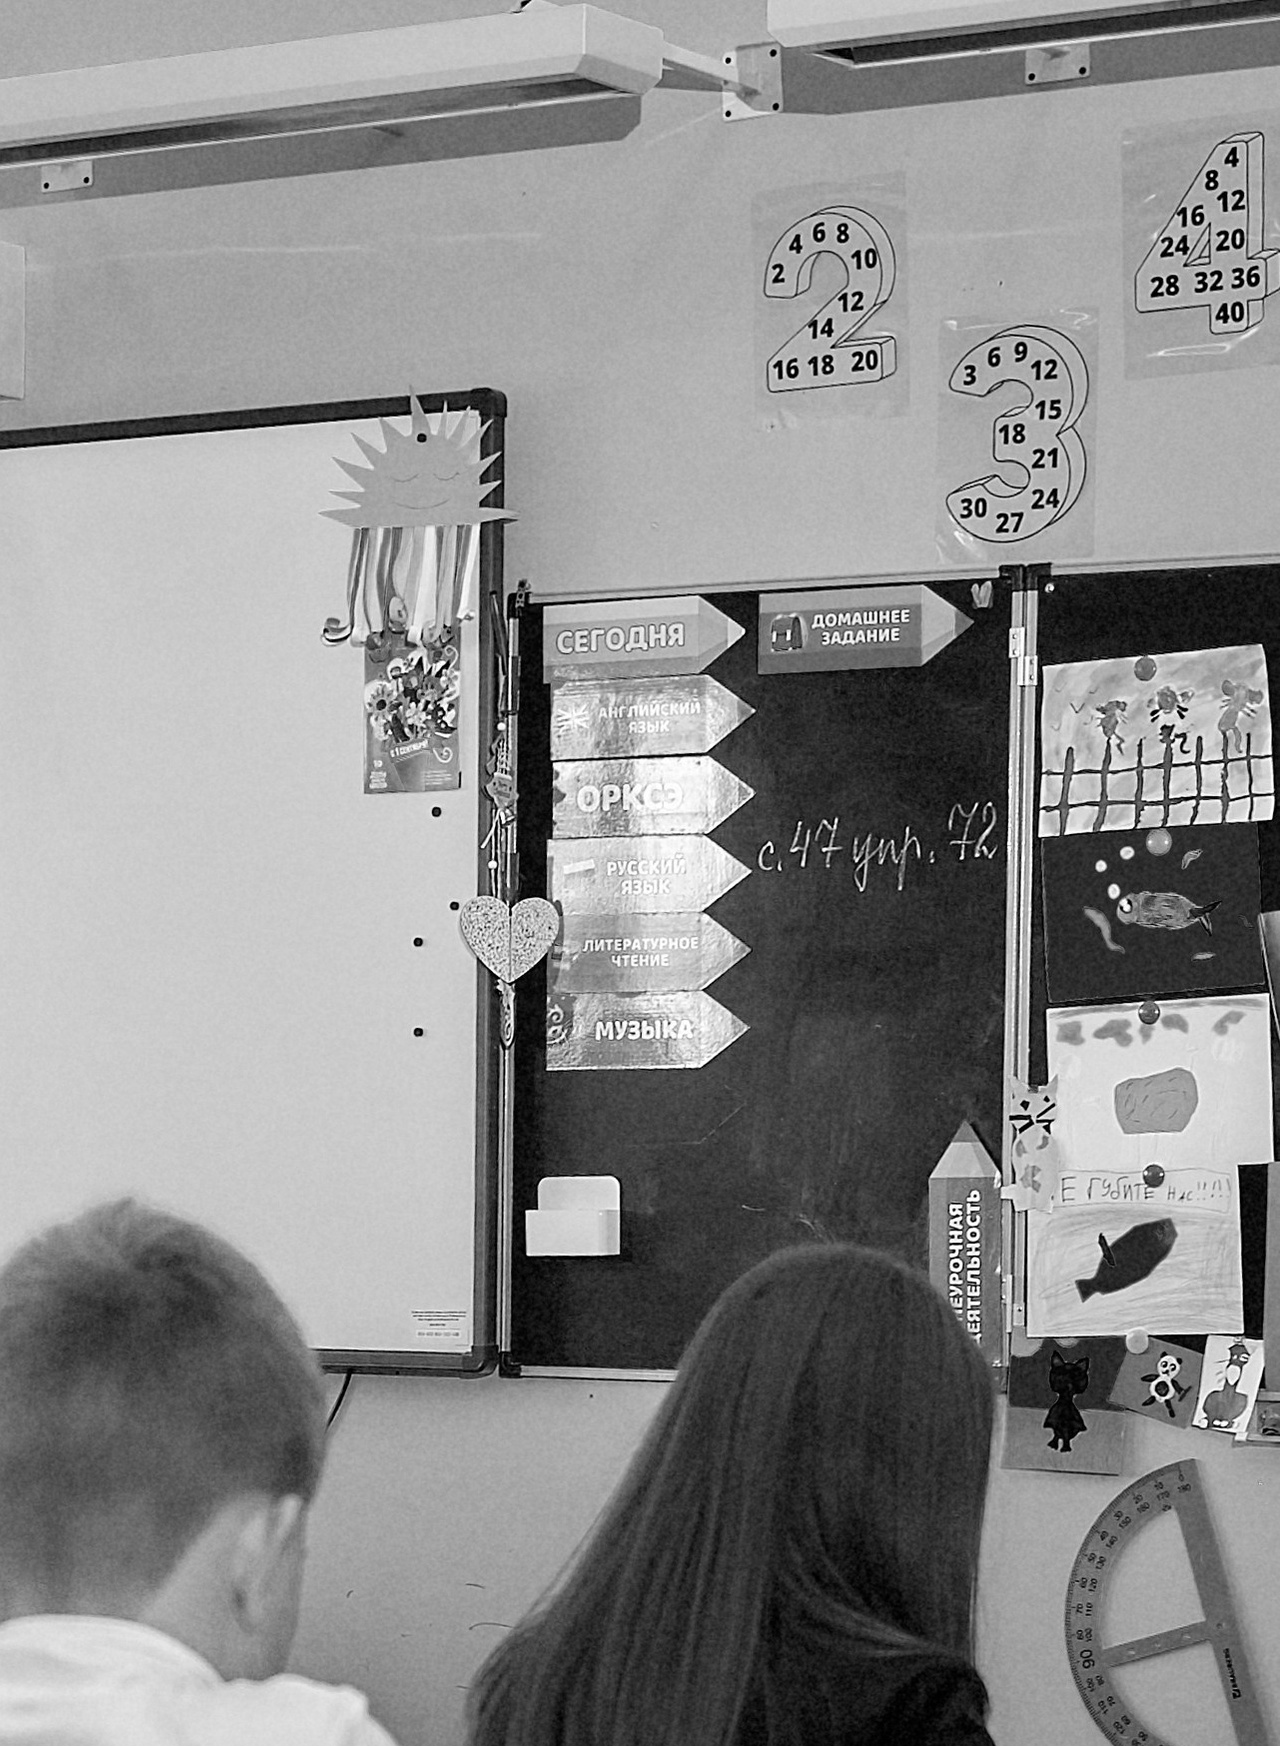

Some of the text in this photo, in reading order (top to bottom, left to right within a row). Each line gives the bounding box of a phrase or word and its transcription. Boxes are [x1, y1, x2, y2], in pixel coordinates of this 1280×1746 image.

[1225, 147, 1240, 168] 4
[1204, 170, 1219, 191] 8
[1217, 190, 1246, 212] 12
[1176, 205, 1205, 227] 16
[1160, 235, 1190, 257] 24
[1216, 229, 1245, 251] 20
[771, 222, 878, 284] 2 4 6 8 10
[1150, 266, 1261, 298] 28 32 36
[838, 291, 864, 312] 12
[1216, 302, 1245, 323] 40
[808, 318, 834, 339] 14
[773, 350, 879, 380] 16 18 20
[963, 342, 1058, 386] 3 6 9 12
[1035, 398, 1062, 420] 15
[999, 423, 1026, 445] 18
[1031, 448, 1059, 469] 21
[960, 497, 988, 519] 30
[1031, 487, 1060, 509] 24
[996, 512, 1024, 533] 27
[811, 609, 910, 629] ДОМАШНЕЕ
[556, 622, 685, 655] СЕГОДНЯ
[821, 627, 900, 646] ЗАДАНИЕ
[598, 698, 701, 719] АНГЛИЙСКИЙ
[628, 720, 670, 734] ЯЗЫК
[577, 782, 683, 813] ОРКСЭ
[789, 816, 844, 869] 47
[852, 825, 936, 893] упр.
[948, 801, 999, 861] 72
[606, 853, 687, 876] РУССКИЙ
[621, 879, 671, 895] ЯЗЫК
[582, 936, 699, 952] ЛИТЕРАТУРНОЕ
[611, 954, 670, 967] ЧТЕНИЕ
[595, 1019, 694, 1041] МУЗЫКА
[948, 1202, 964, 1322] ЕУРОЧНАЯ
[1080, 1649, 1095, 1670] 90
